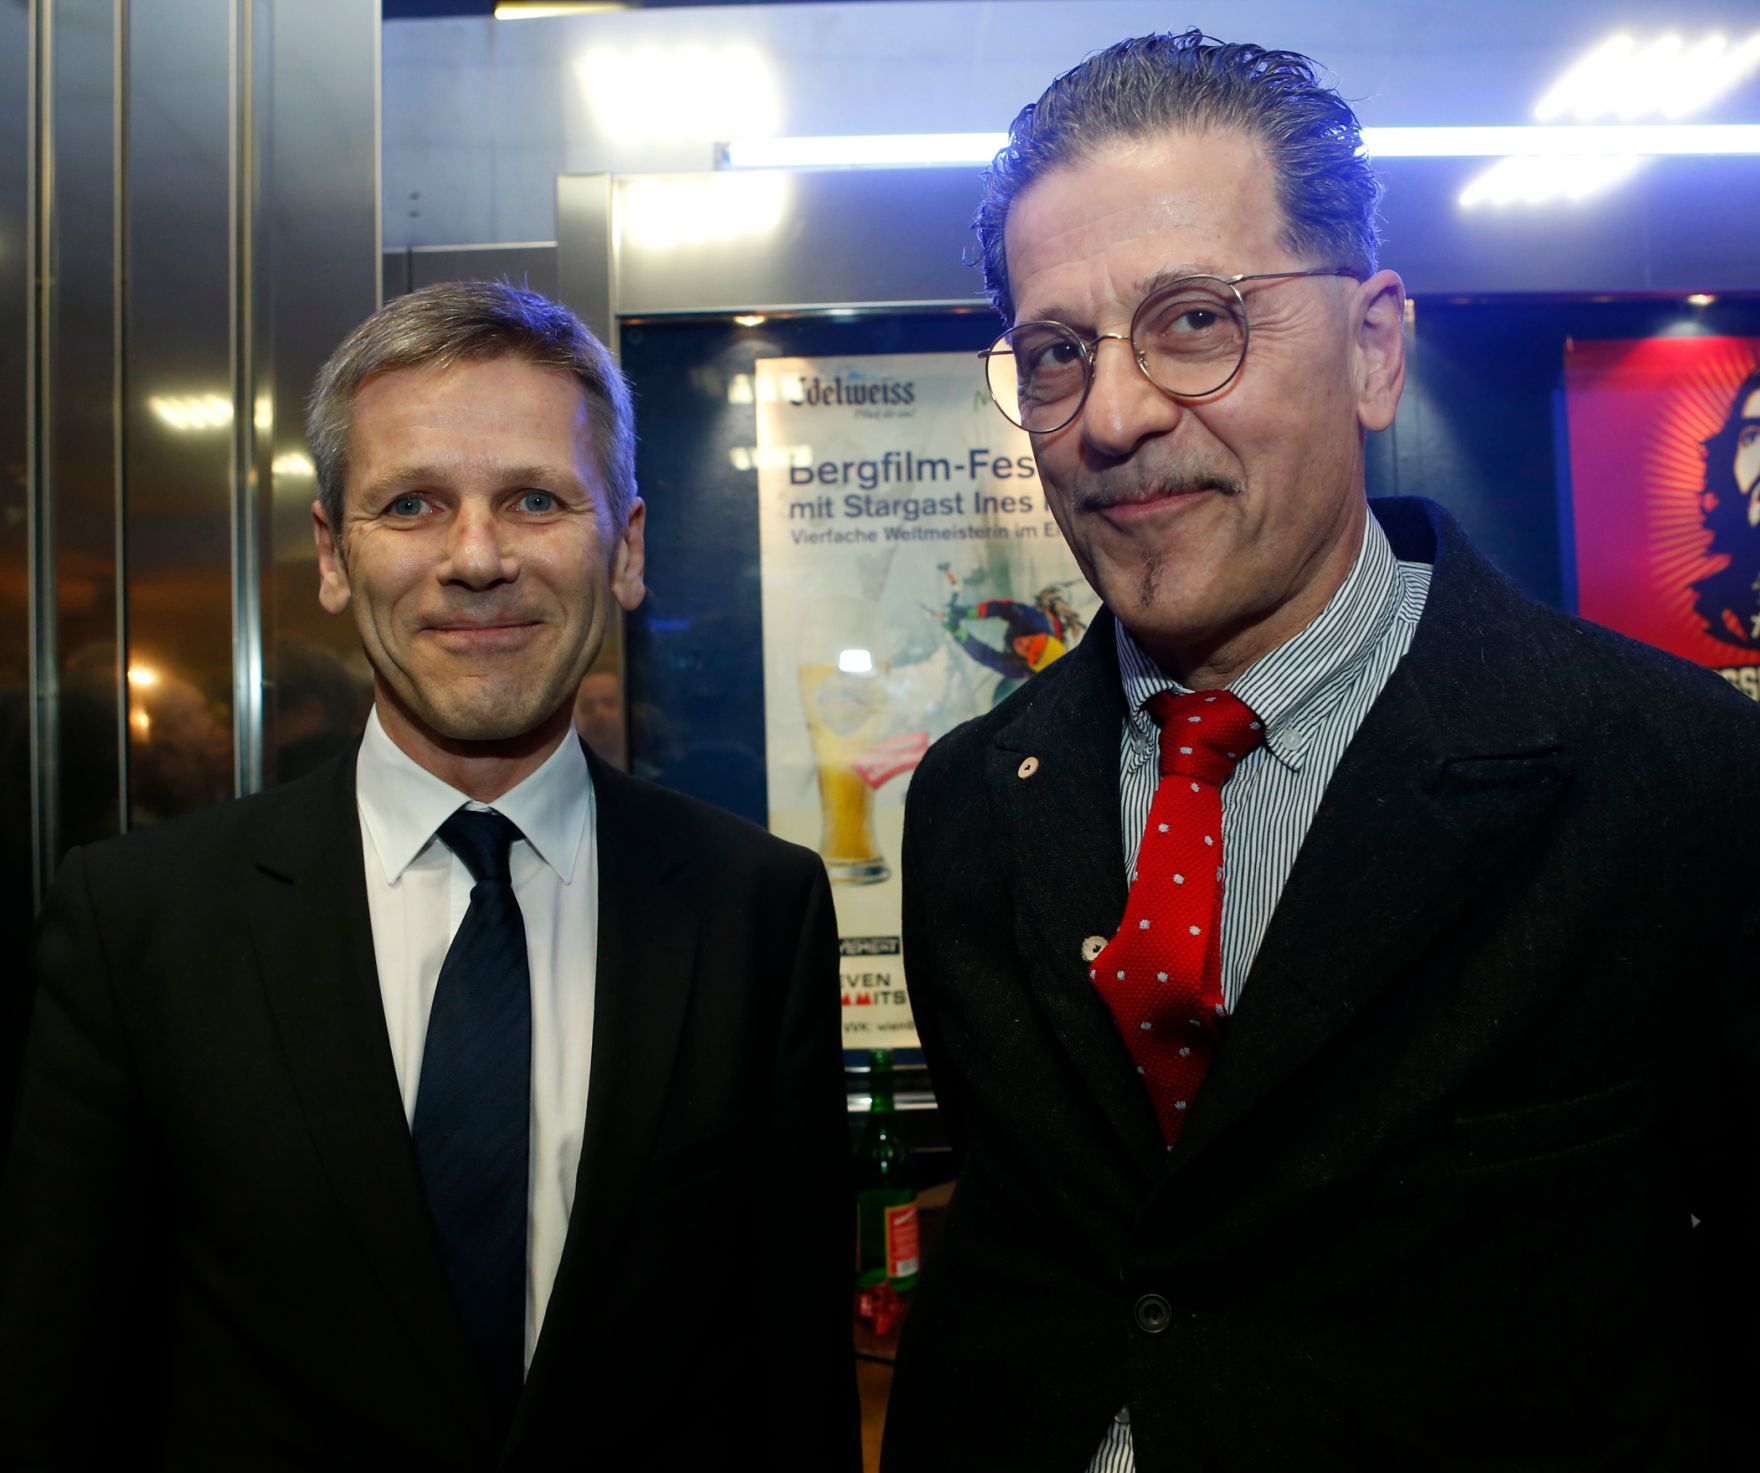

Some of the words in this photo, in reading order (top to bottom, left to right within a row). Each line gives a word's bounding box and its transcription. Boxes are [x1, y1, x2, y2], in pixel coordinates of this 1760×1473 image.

[790, 376, 916, 406] delweiss
[790, 496, 833, 519] mit
[844, 493, 964, 520] Stargast
[975, 491, 1032, 513] Ines
[791, 527, 877, 545] Vierfache
[883, 522, 1009, 542] Weltmeisterin
[1014, 522, 1037, 537] im
